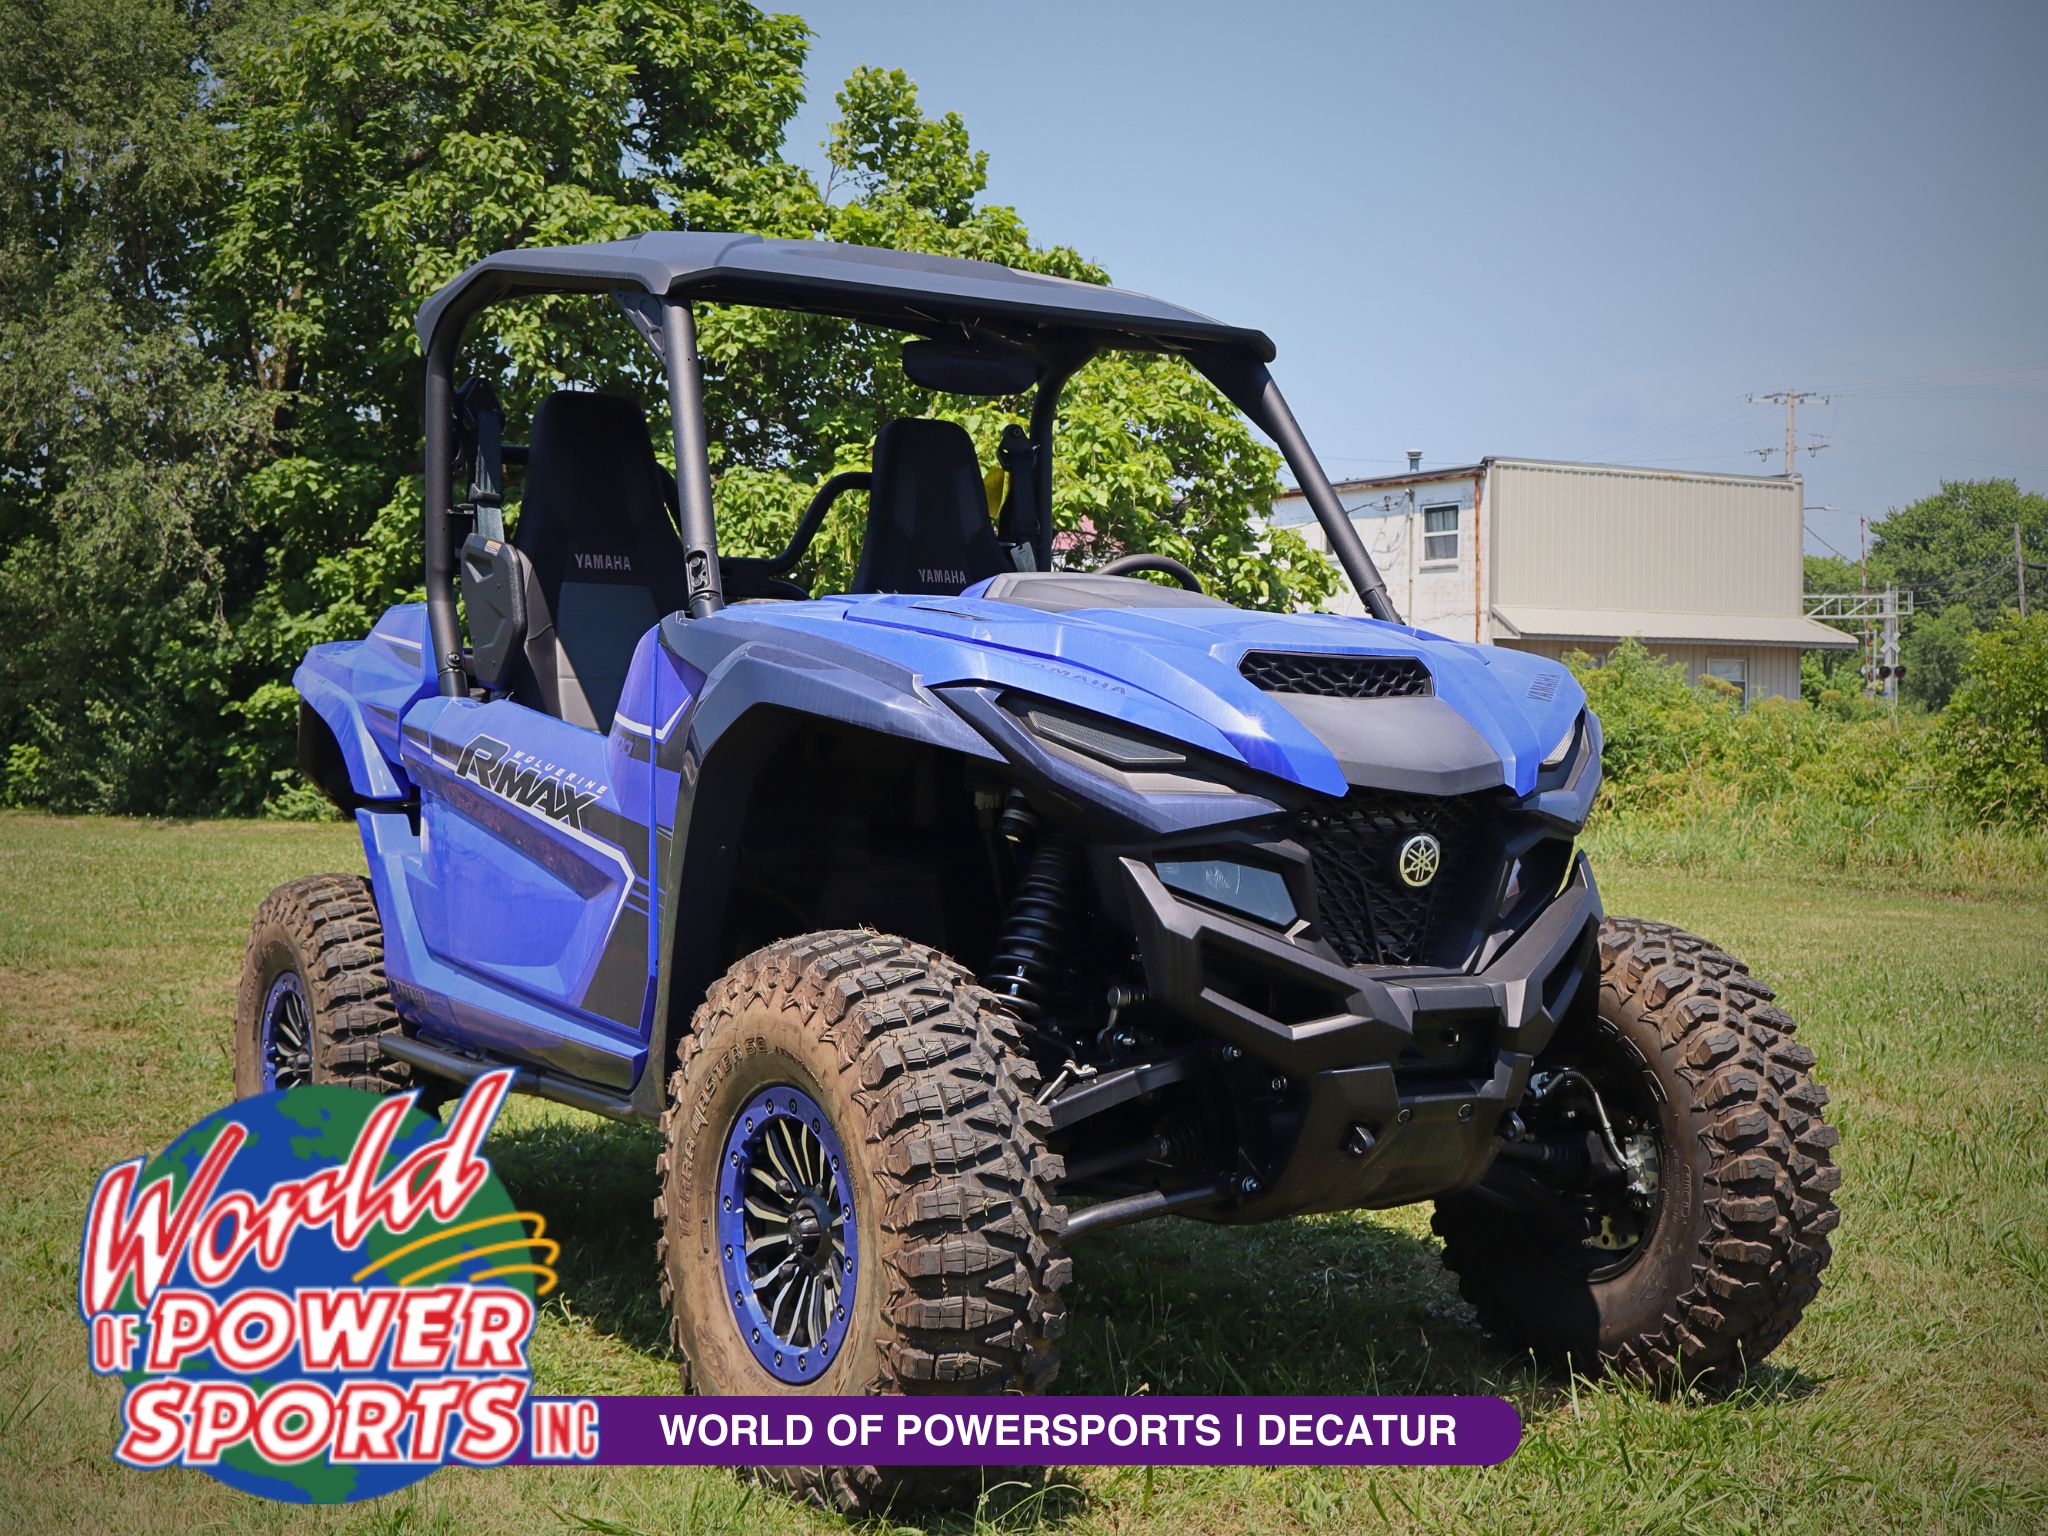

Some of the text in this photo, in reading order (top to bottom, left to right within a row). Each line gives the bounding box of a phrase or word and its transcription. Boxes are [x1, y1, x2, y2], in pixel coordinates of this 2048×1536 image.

[574, 552, 632, 571] YAMAHA
[918, 568, 966, 584] YAMAHA
[1526, 672, 1561, 703] YAMAHA
[455, 733, 601, 832] RMAX
[512, 749, 608, 794] WOLVERINE
[677, 1136, 698, 1238] TERRA
